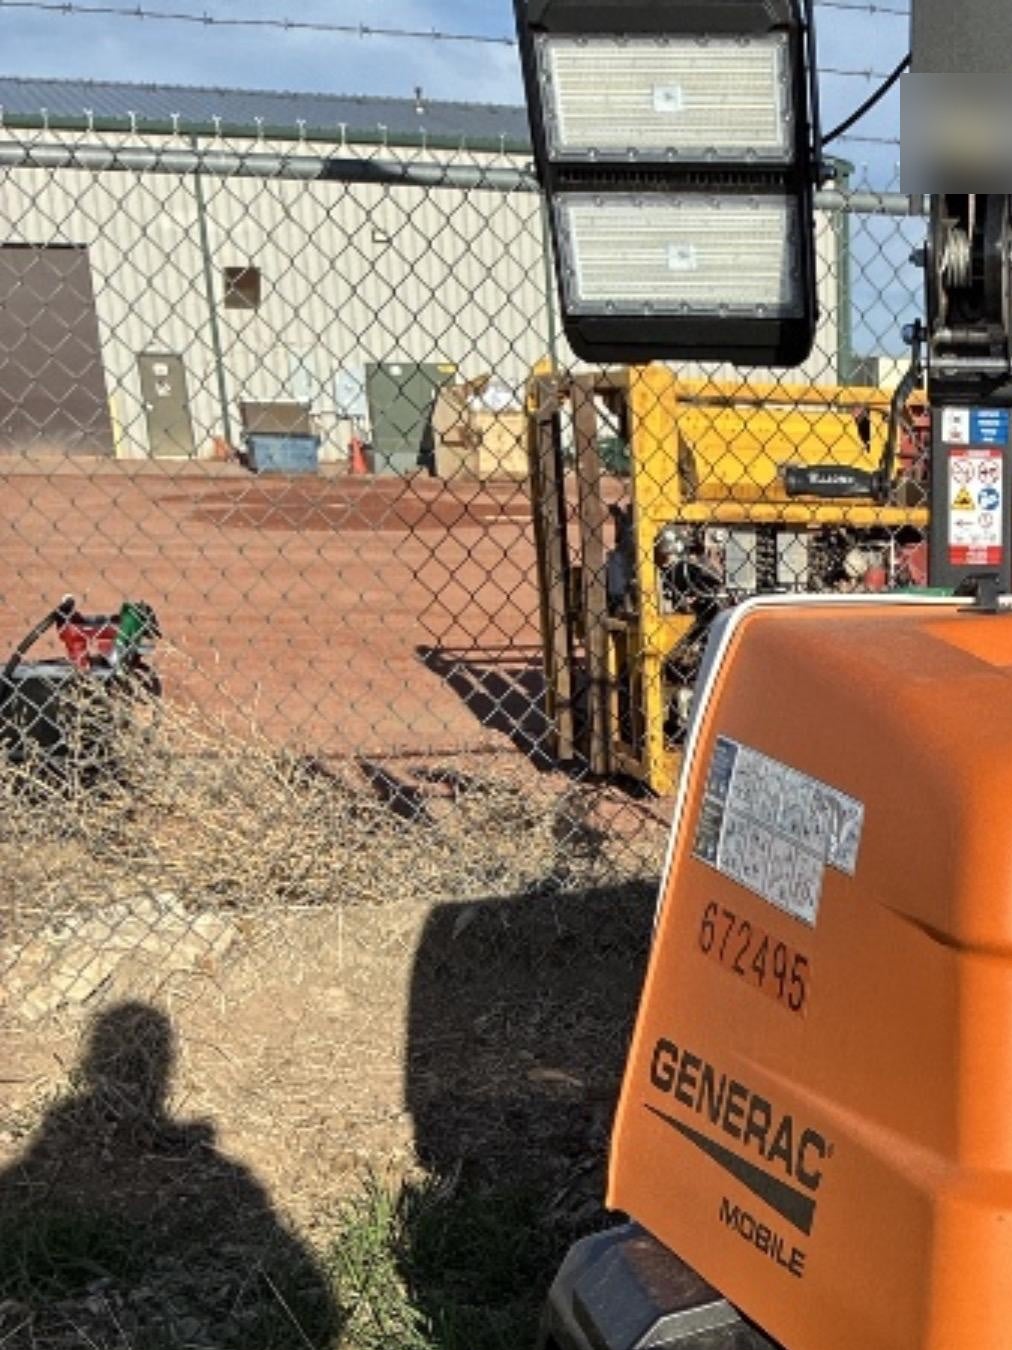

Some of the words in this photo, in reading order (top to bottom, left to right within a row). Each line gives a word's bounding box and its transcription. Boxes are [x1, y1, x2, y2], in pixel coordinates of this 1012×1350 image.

[700, 901, 808, 1012] 672495
[650, 1037, 826, 1192] GENERAC
[718, 1197, 806, 1279] MOBILE
